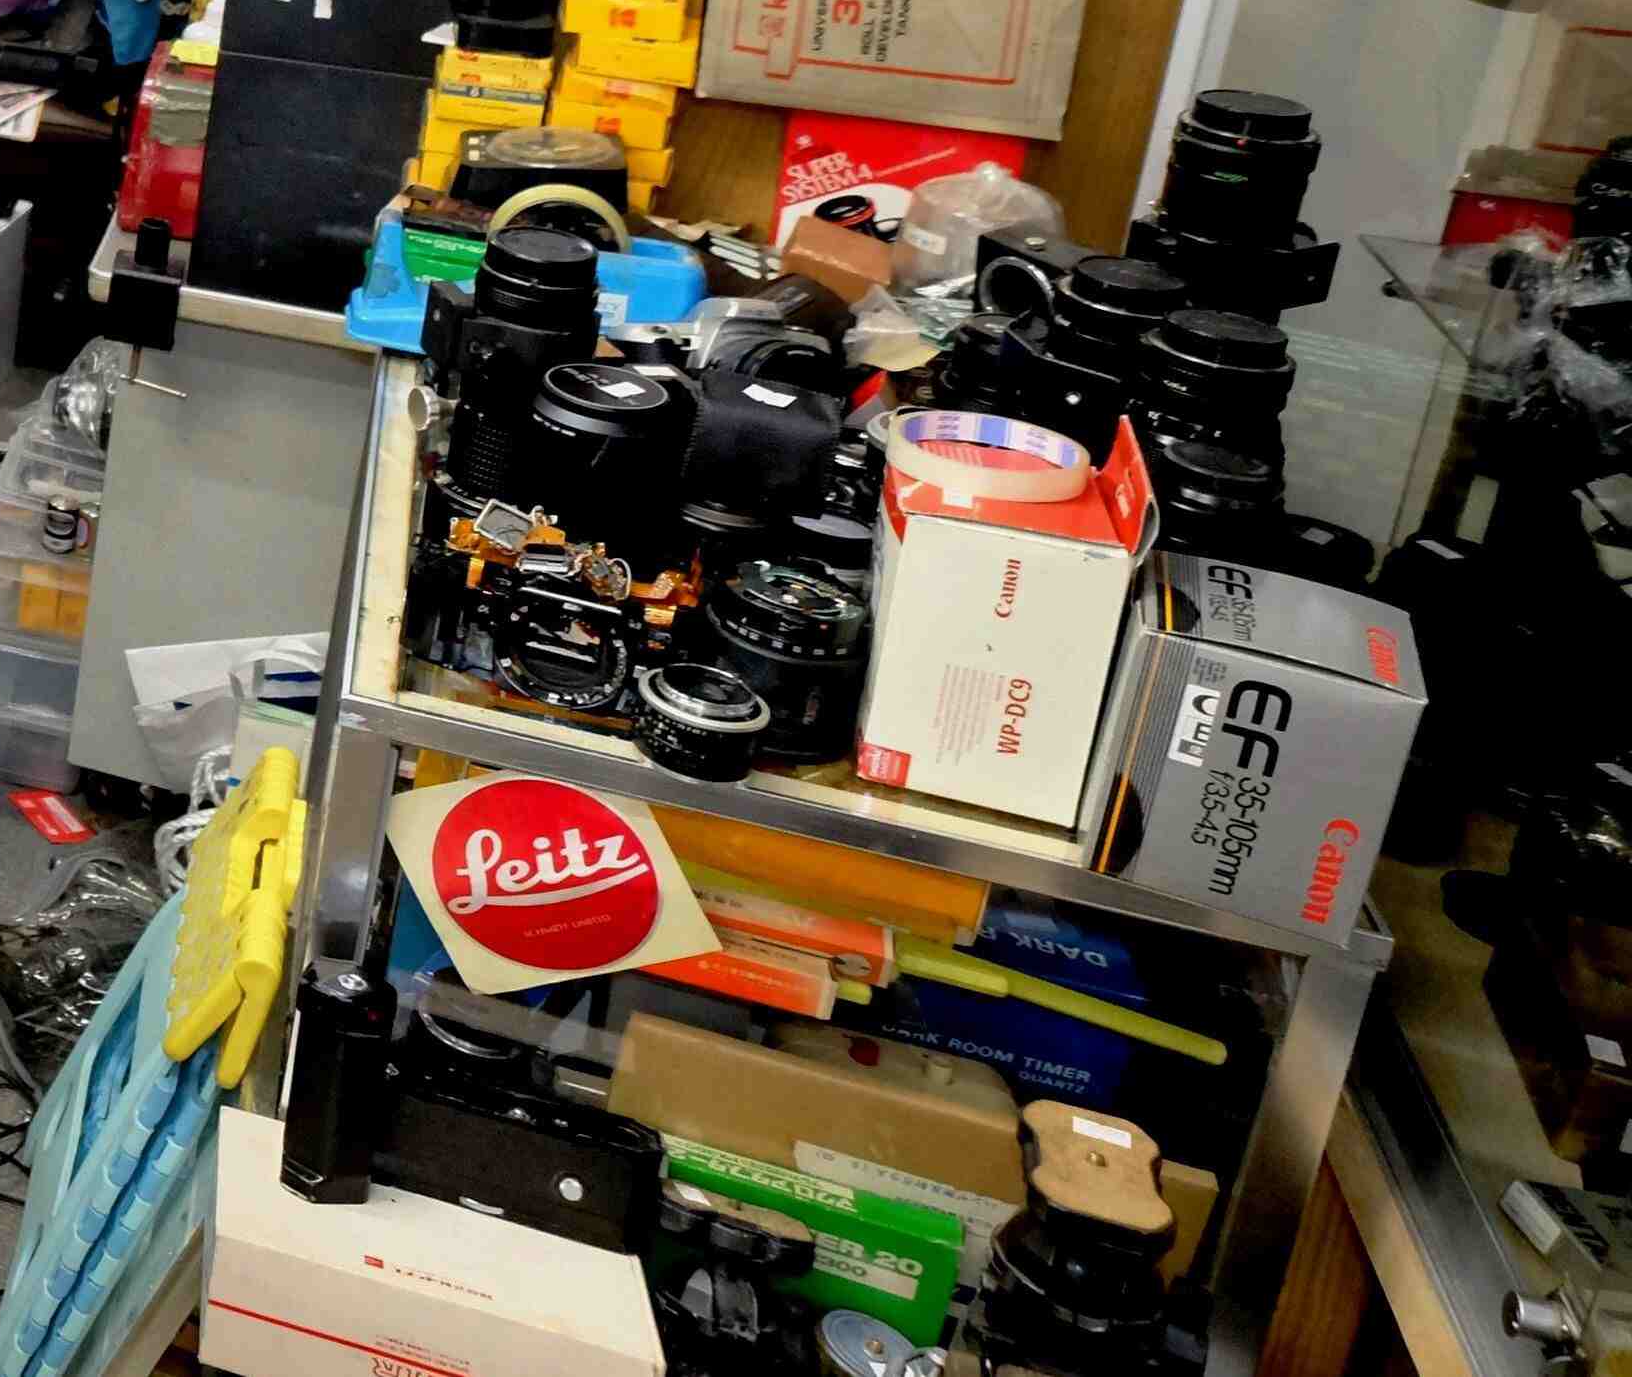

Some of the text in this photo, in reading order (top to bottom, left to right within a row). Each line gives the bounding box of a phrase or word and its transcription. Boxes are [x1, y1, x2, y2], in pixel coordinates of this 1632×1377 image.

[860, 18, 875, 55] ROLL
[781, 163, 874, 204] SYSTEM 4
[785, 151, 854, 184] SUPER
[993, 556, 1024, 620] Canon
[1206, 564, 1252, 605] EF
[1365, 625, 1400, 685] Canon
[995, 677, 1033, 758] WP-DC9
[1189, 768, 1229, 849] f/3.5-4.5
[1208, 679, 1293, 898] EF 35-105mm
[447, 827, 643, 915] Leitz
[1301, 817, 1359, 925] Canon
[947, 1036, 1092, 1084] ROOM TIMER
[1017, 1070, 1088, 1095] QUARTZ
[872, 1250, 923, 1277] 20
